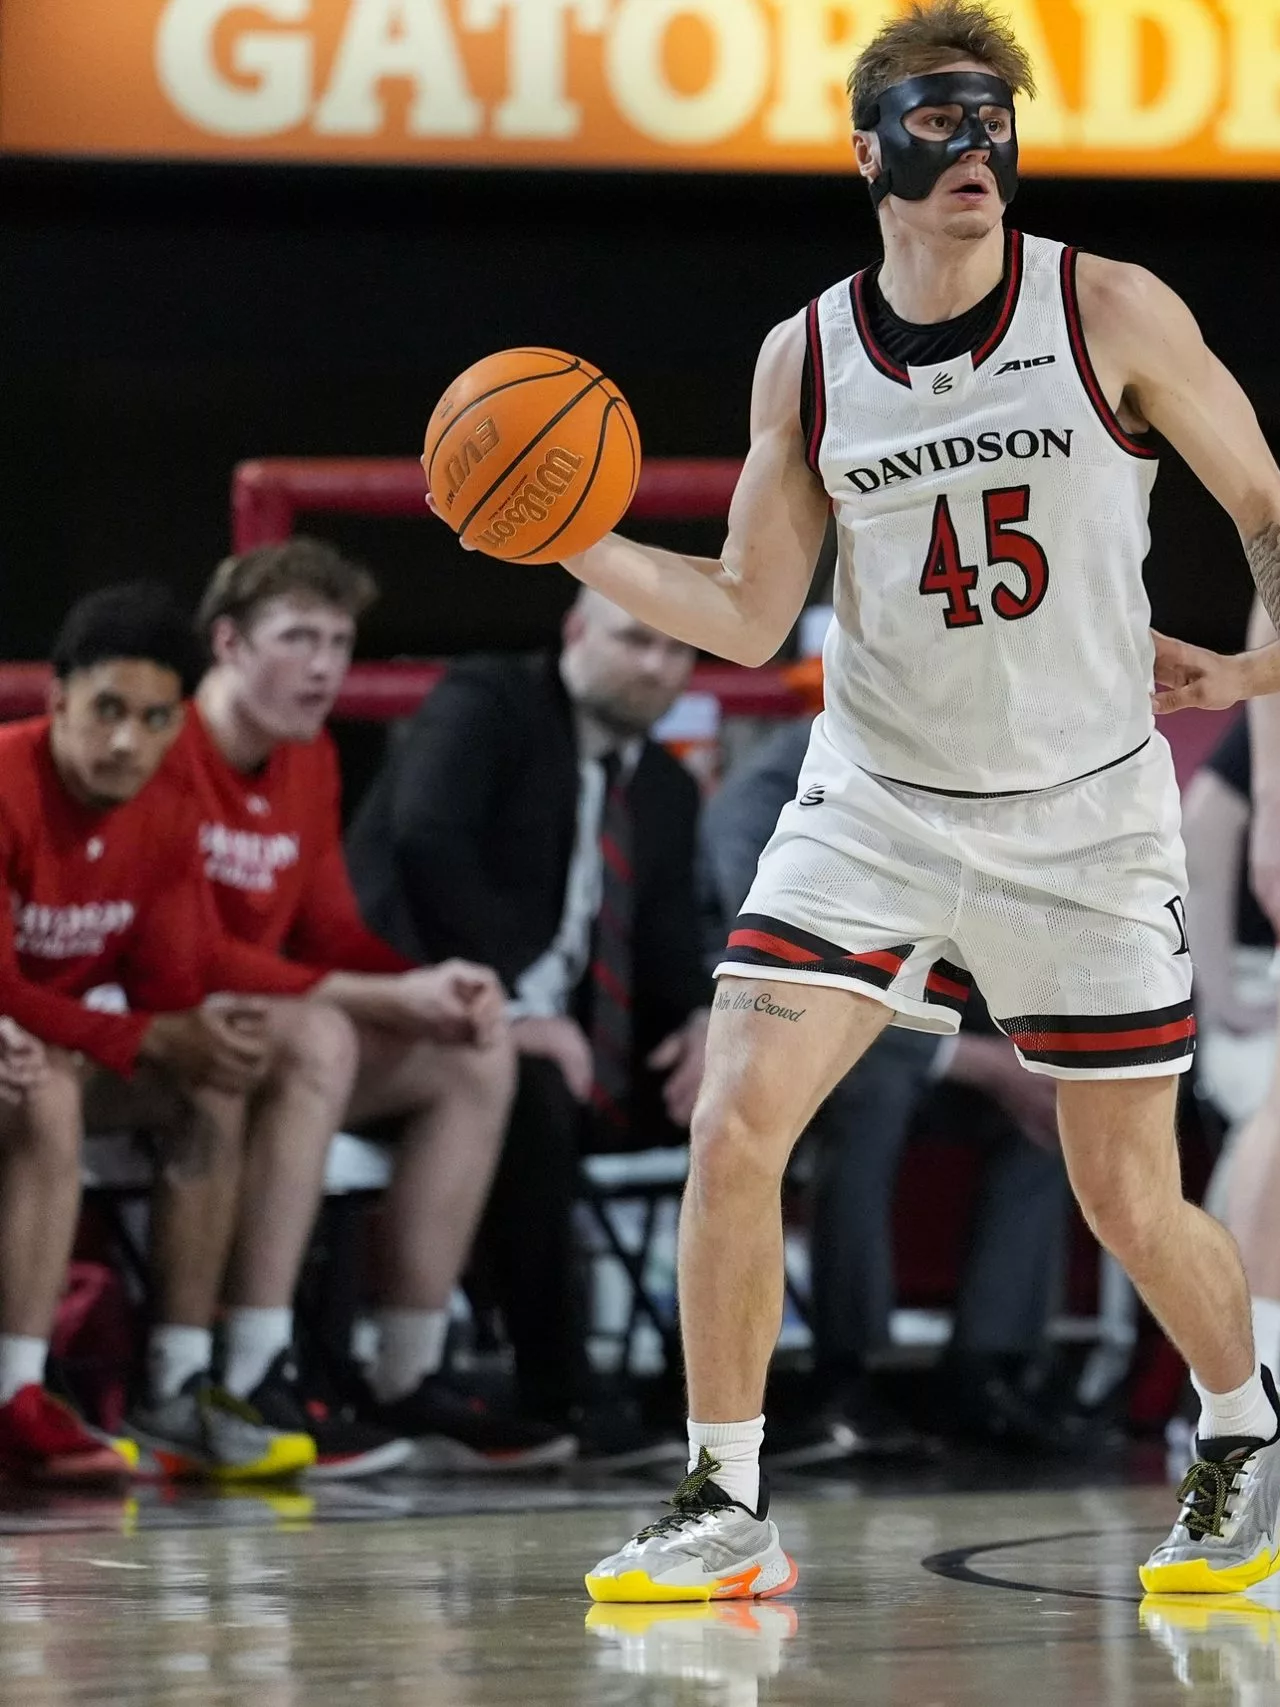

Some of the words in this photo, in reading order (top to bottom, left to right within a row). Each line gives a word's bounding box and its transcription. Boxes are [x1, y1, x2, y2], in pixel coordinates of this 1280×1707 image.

[992, 354, 1056, 376] A10
[844, 428, 1074, 494] DAVIDSON
[473, 446, 585, 549] Wilson
[918, 483, 1050, 629] 45
[732, 991, 753, 1010] the
[753, 993, 806, 1022] Crowd
